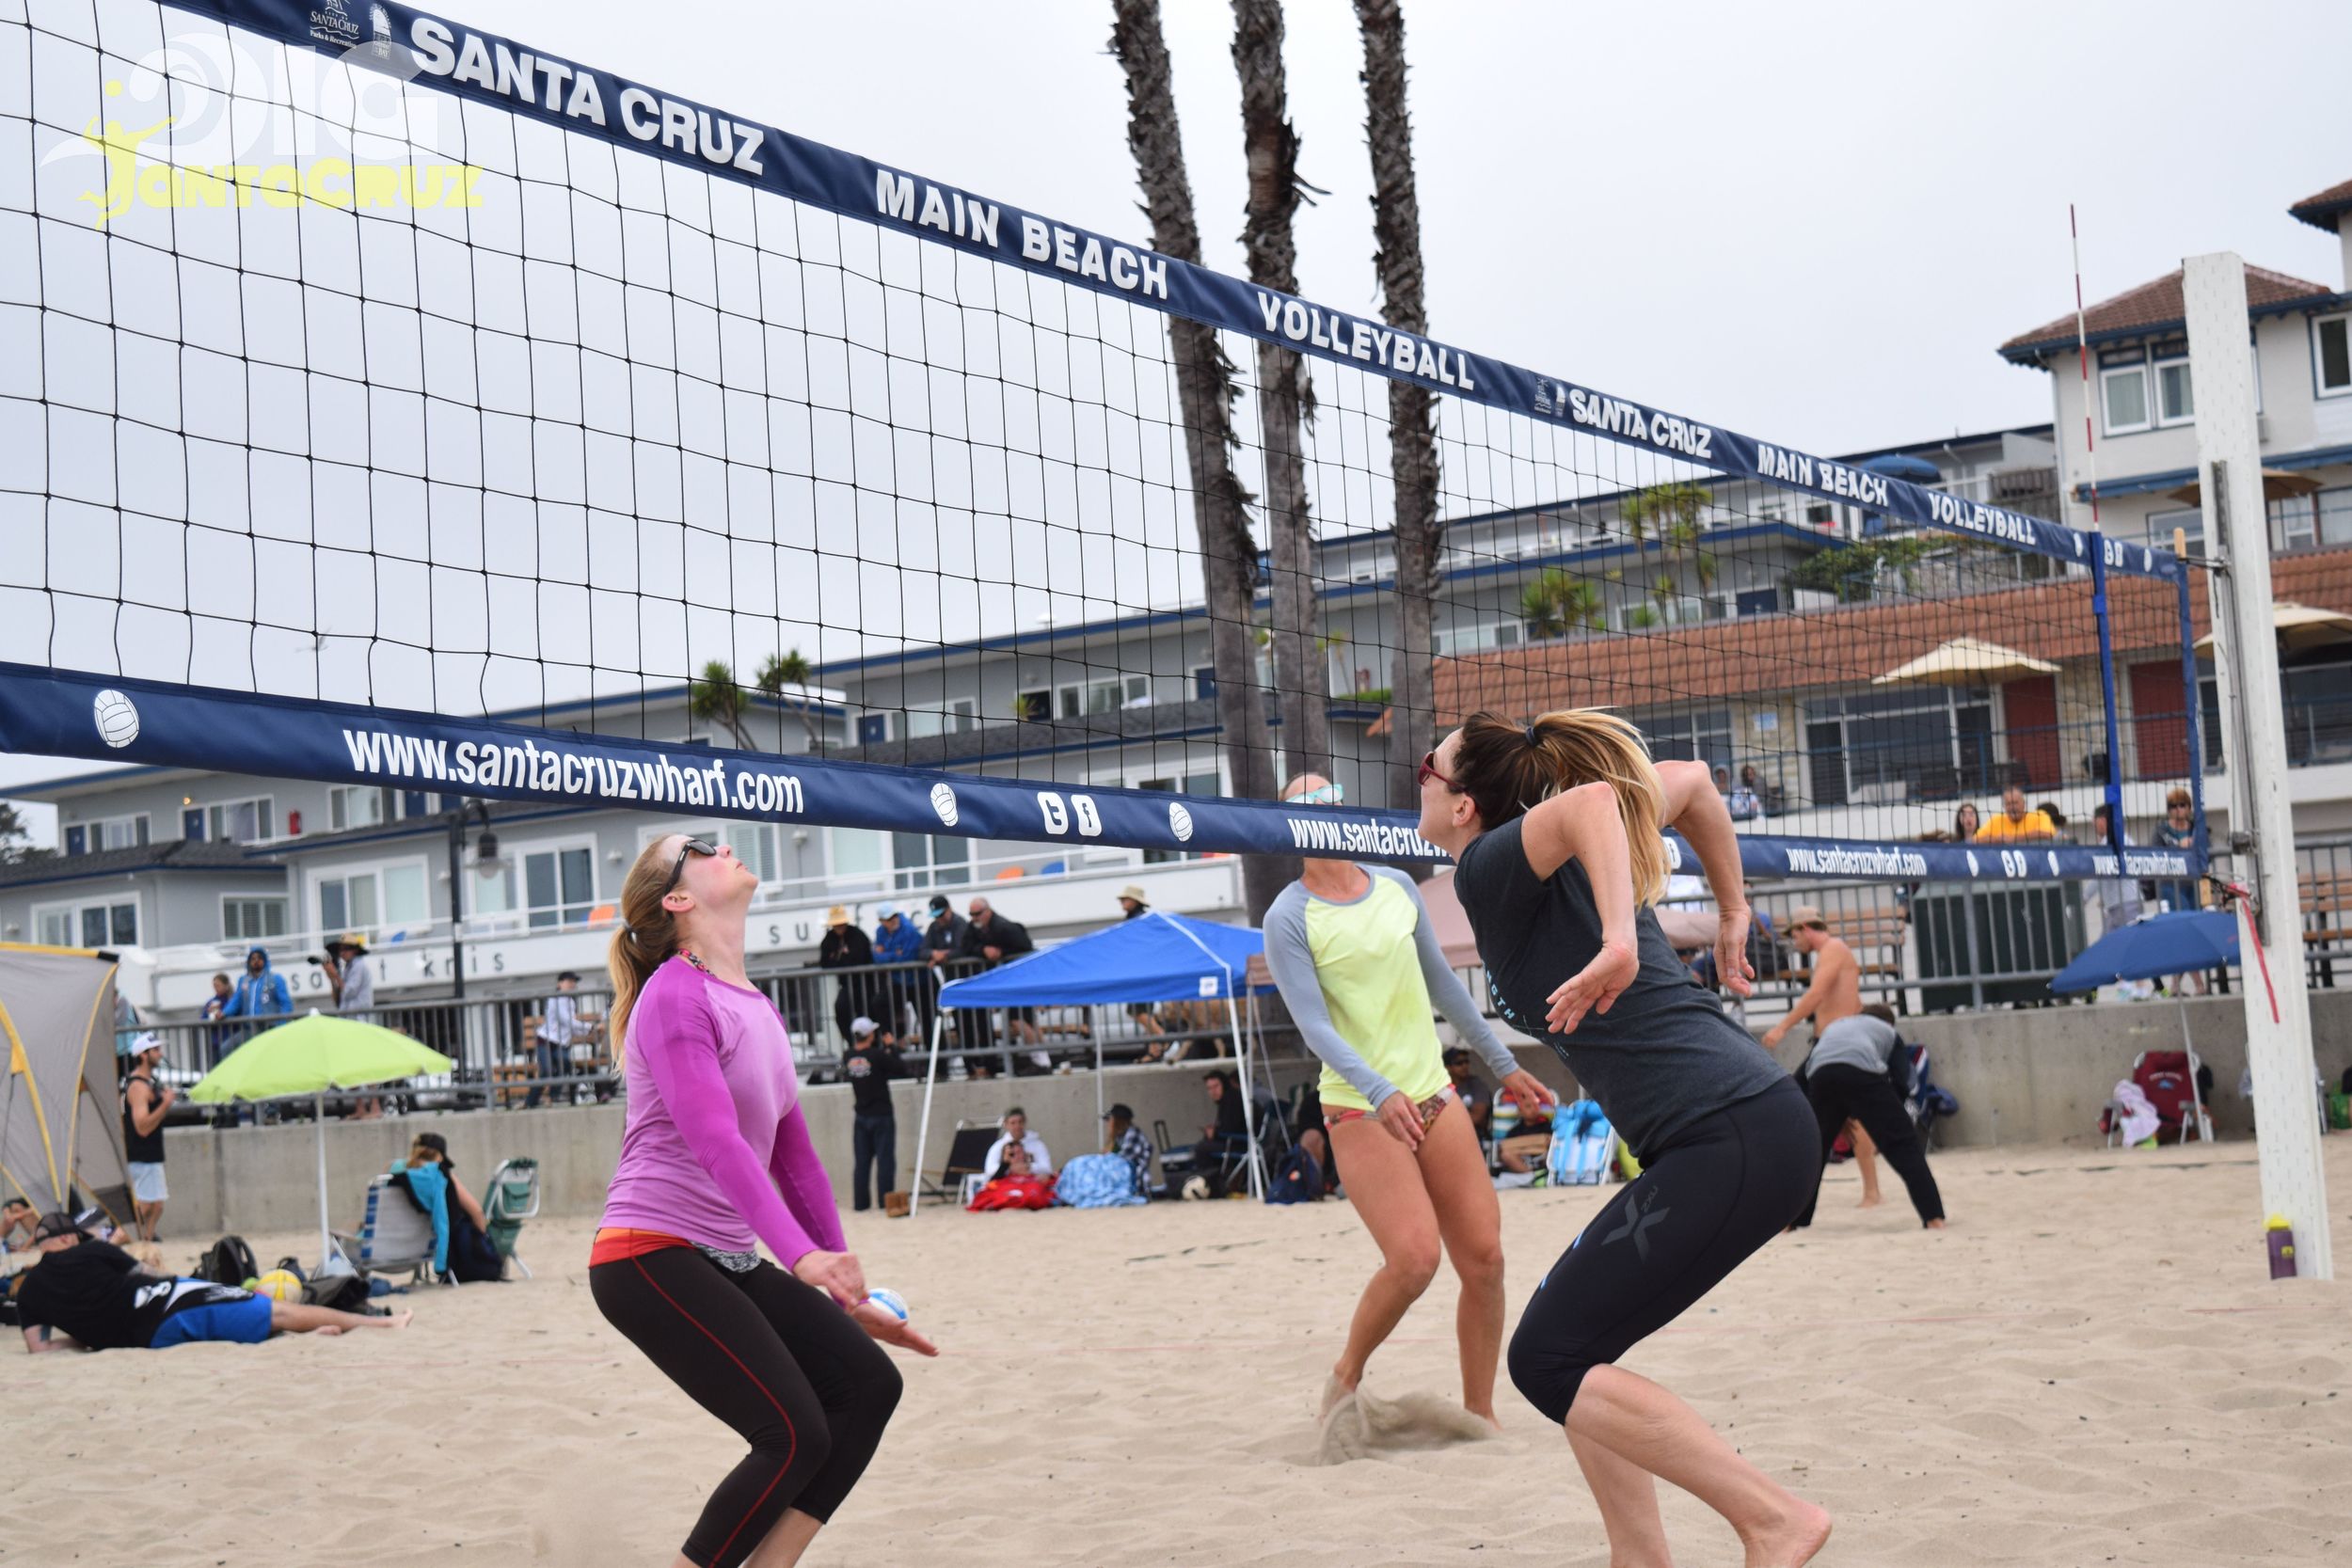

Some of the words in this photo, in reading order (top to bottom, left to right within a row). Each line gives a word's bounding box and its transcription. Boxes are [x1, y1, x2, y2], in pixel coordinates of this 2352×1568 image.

[410, 17, 607, 127] SANTA
[619, 87, 765, 177] CRUZ
[876, 168, 999, 248] MAIN
[1022, 215, 1168, 300] BEACH
[1257, 292, 1475, 391] VOLLEYBALL
[1569, 388, 1647, 441] SANTA
[1650, 413, 1712, 460] CRUZ
[1756, 443, 1813, 487] MAIN
[1818, 462, 1889, 508] BEACH
[1928, 492, 2036, 546] VOLLEYBALL
